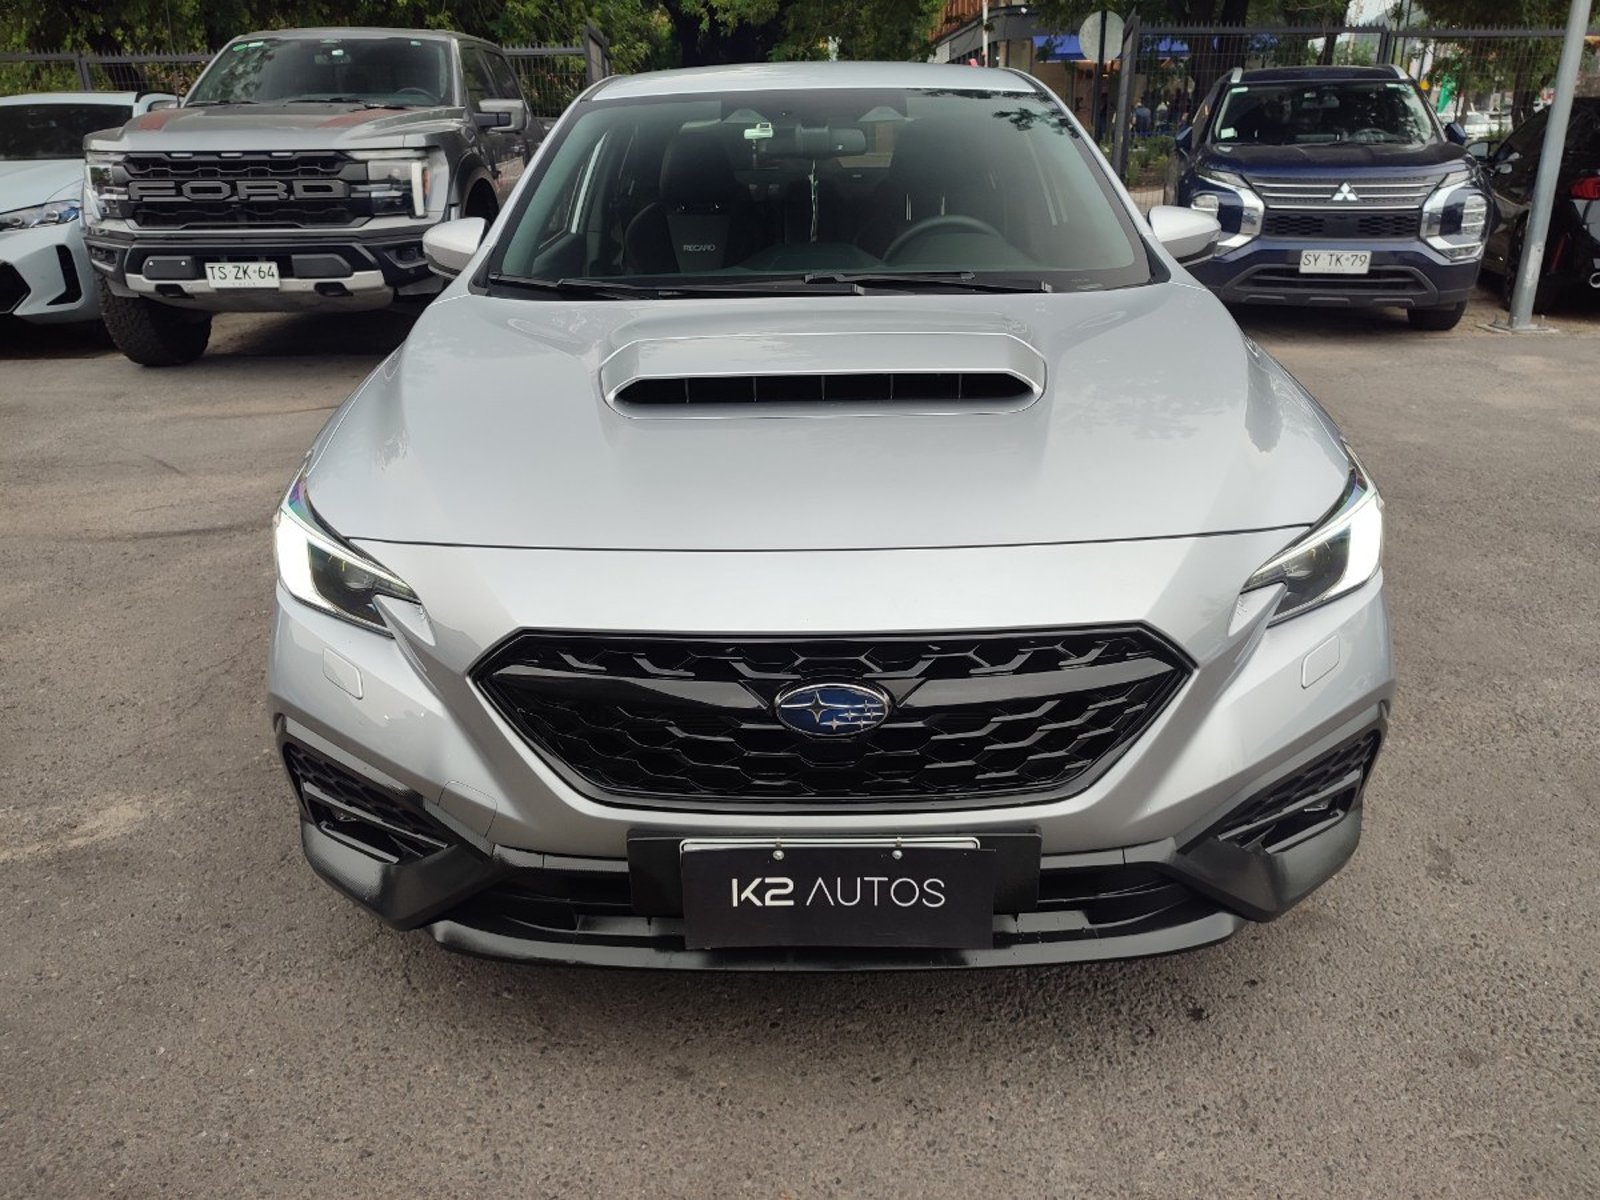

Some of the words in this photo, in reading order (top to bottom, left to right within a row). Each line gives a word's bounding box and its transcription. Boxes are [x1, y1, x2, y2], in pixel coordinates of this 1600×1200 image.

[128, 180, 350, 201] FORD
[732, 877, 795, 907] K2
[805, 877, 946, 908] AUTOS
